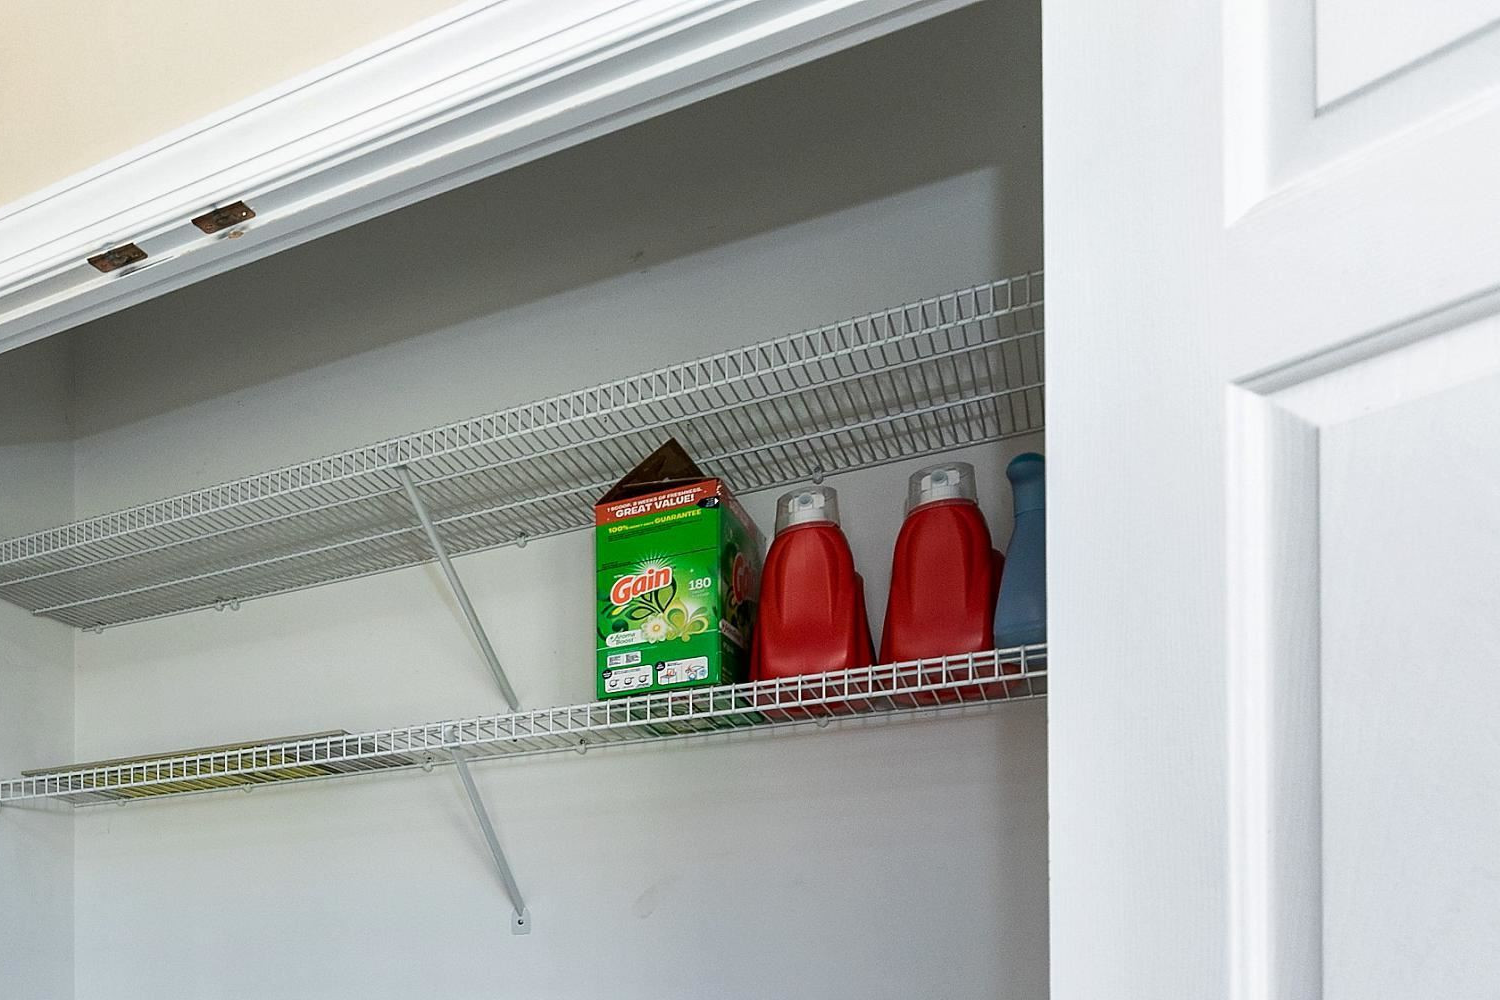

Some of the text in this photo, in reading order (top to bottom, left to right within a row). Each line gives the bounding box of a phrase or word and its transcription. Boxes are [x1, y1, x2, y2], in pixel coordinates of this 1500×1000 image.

[615, 503, 653, 518] GREAT
[654, 494, 695, 510] VALUE!
[608, 524, 629, 534] 100%
[654, 508, 702, 524] GUARANTEE
[611, 567, 673, 606] Gain
[688, 577, 712, 591] 180
